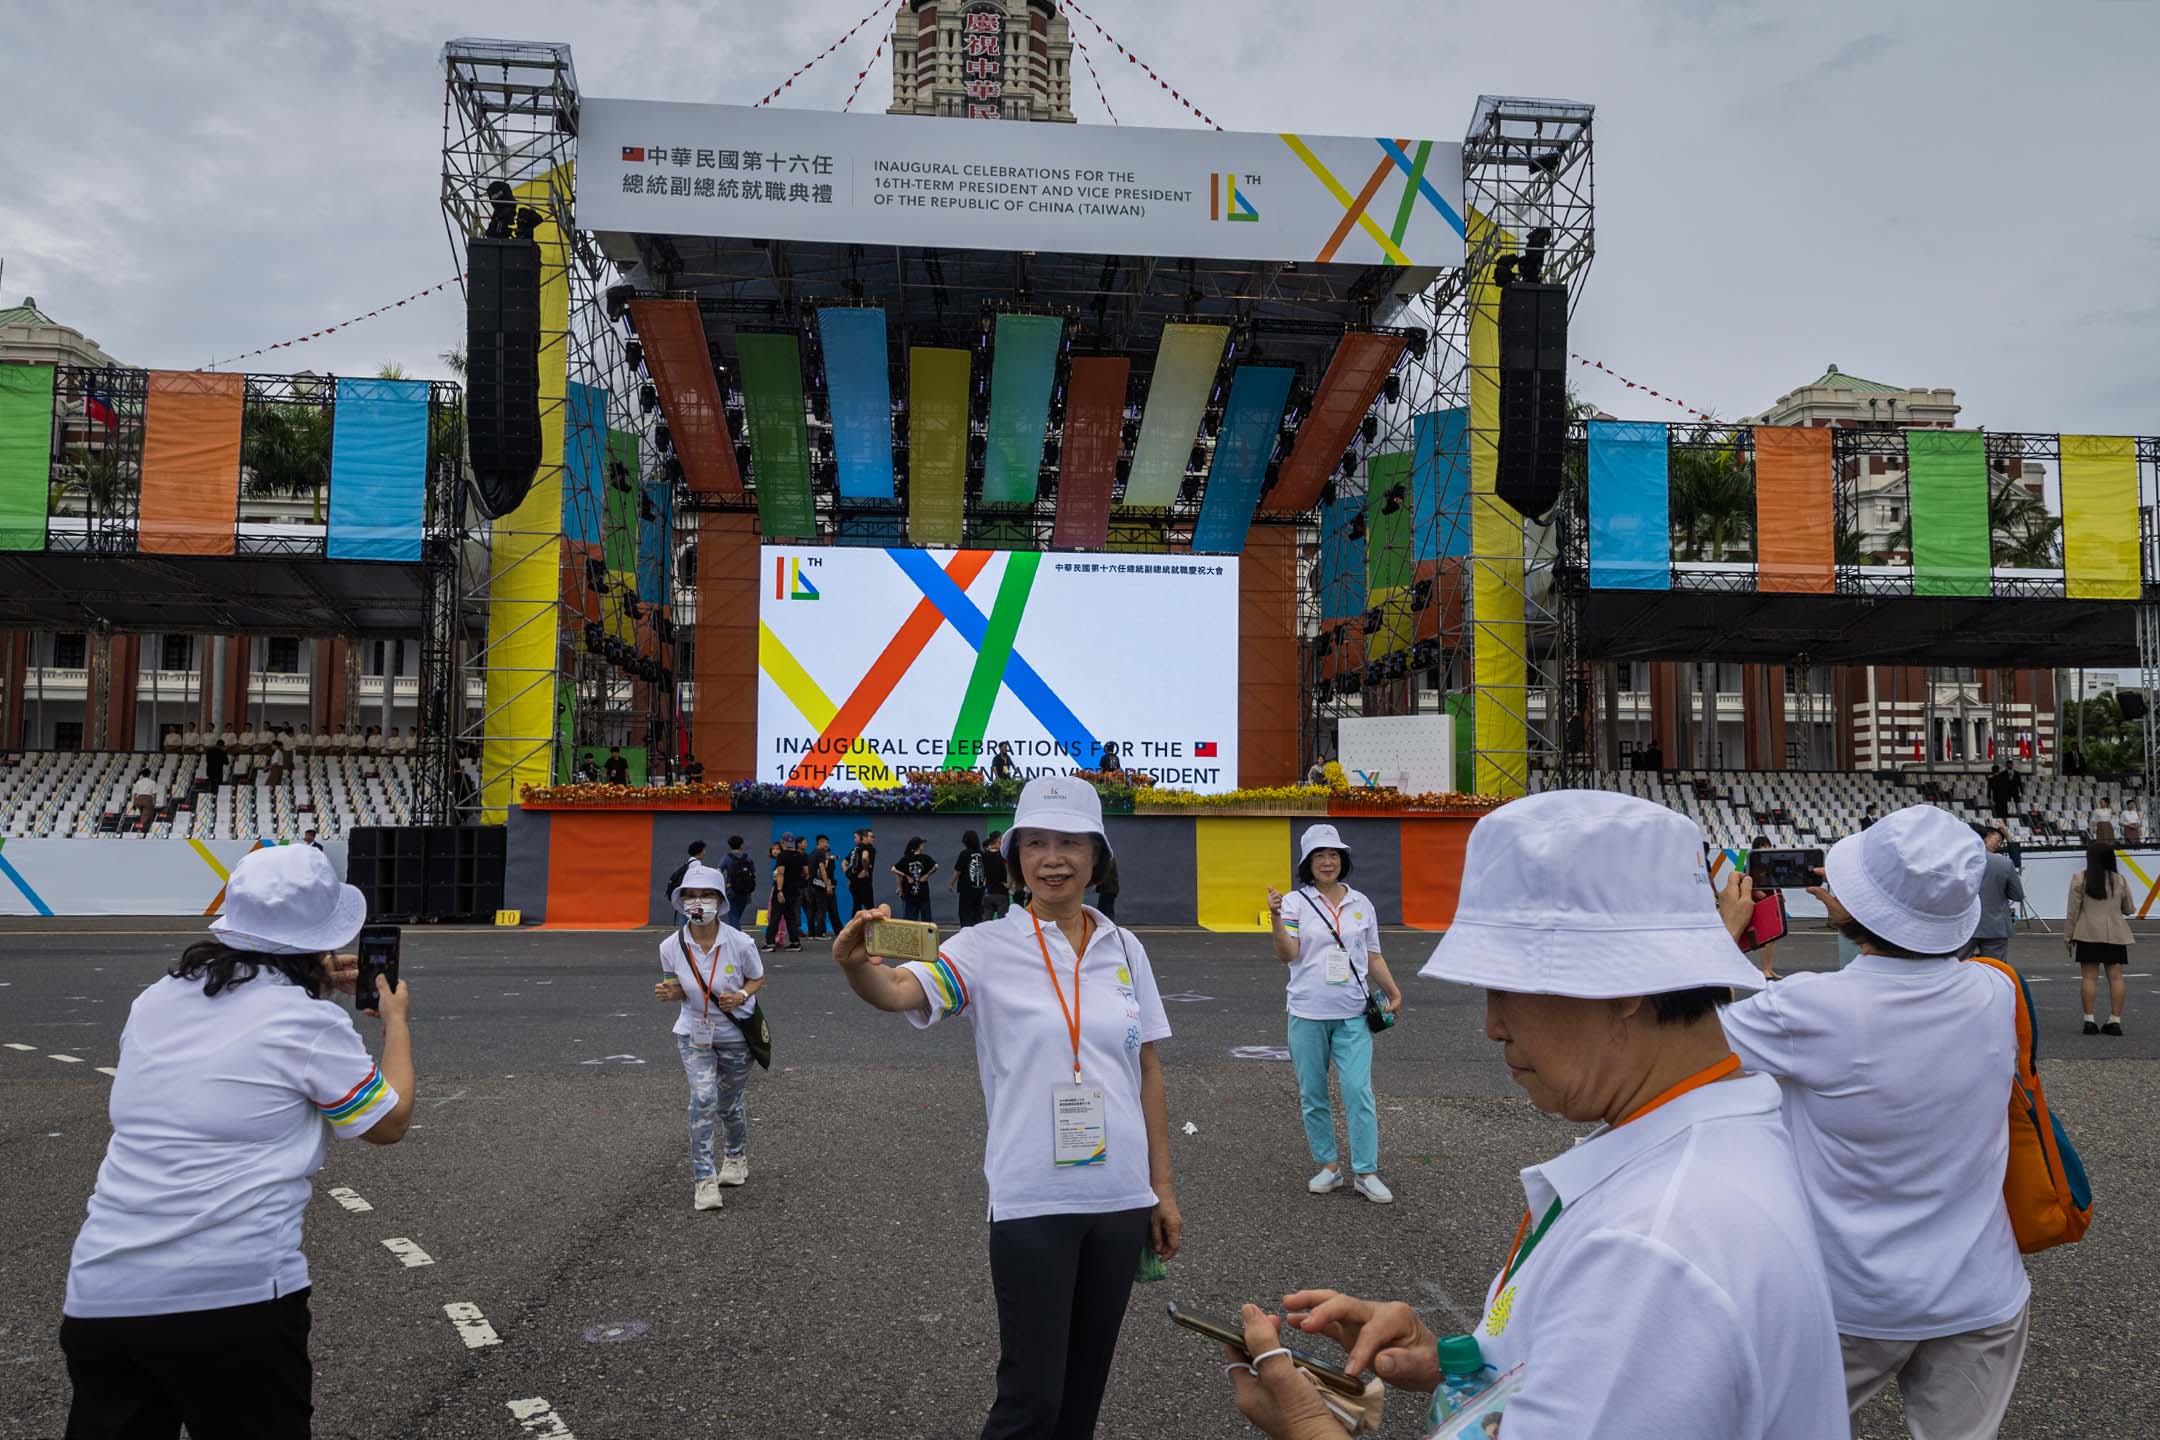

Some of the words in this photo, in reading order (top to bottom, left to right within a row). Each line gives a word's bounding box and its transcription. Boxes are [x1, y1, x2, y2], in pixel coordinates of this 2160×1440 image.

[648, 146, 833, 175] 中華民國第十六任
[874, 161, 959, 175] INAUGURAL
[963, 165, 1070, 180] CELEBRATIONS
[1075, 169, 1103, 181] FOR
[1108, 171, 1135, 183] THE
[622, 173, 833, 203] 總統副總統就職典禮
[874, 177, 954, 191] 16TH-TERM
[959, 181, 1038, 195] PRESIDENT
[1042, 185, 1073, 197] AND
[1078, 187, 1109, 199] VICE
[1114, 188, 1192, 202] PRESIDENT
[874, 194, 894, 206] OF
[898, 194, 926, 207] THE
[931, 196, 1000, 210] REPUBLIC
[1004, 200, 1024, 211] OF
[1028, 201, 1074, 214] CHINA
[1078, 203, 1146, 218] (TAIWAN)
[776, 737, 908, 755] INAUGURAL
[916, 739, 1082, 757] CELEBRATIONS
[1141, 742, 1182, 758] THE
[776, 764, 889, 781] 16TH-TERM
[500, 911, 516, 924] 10
